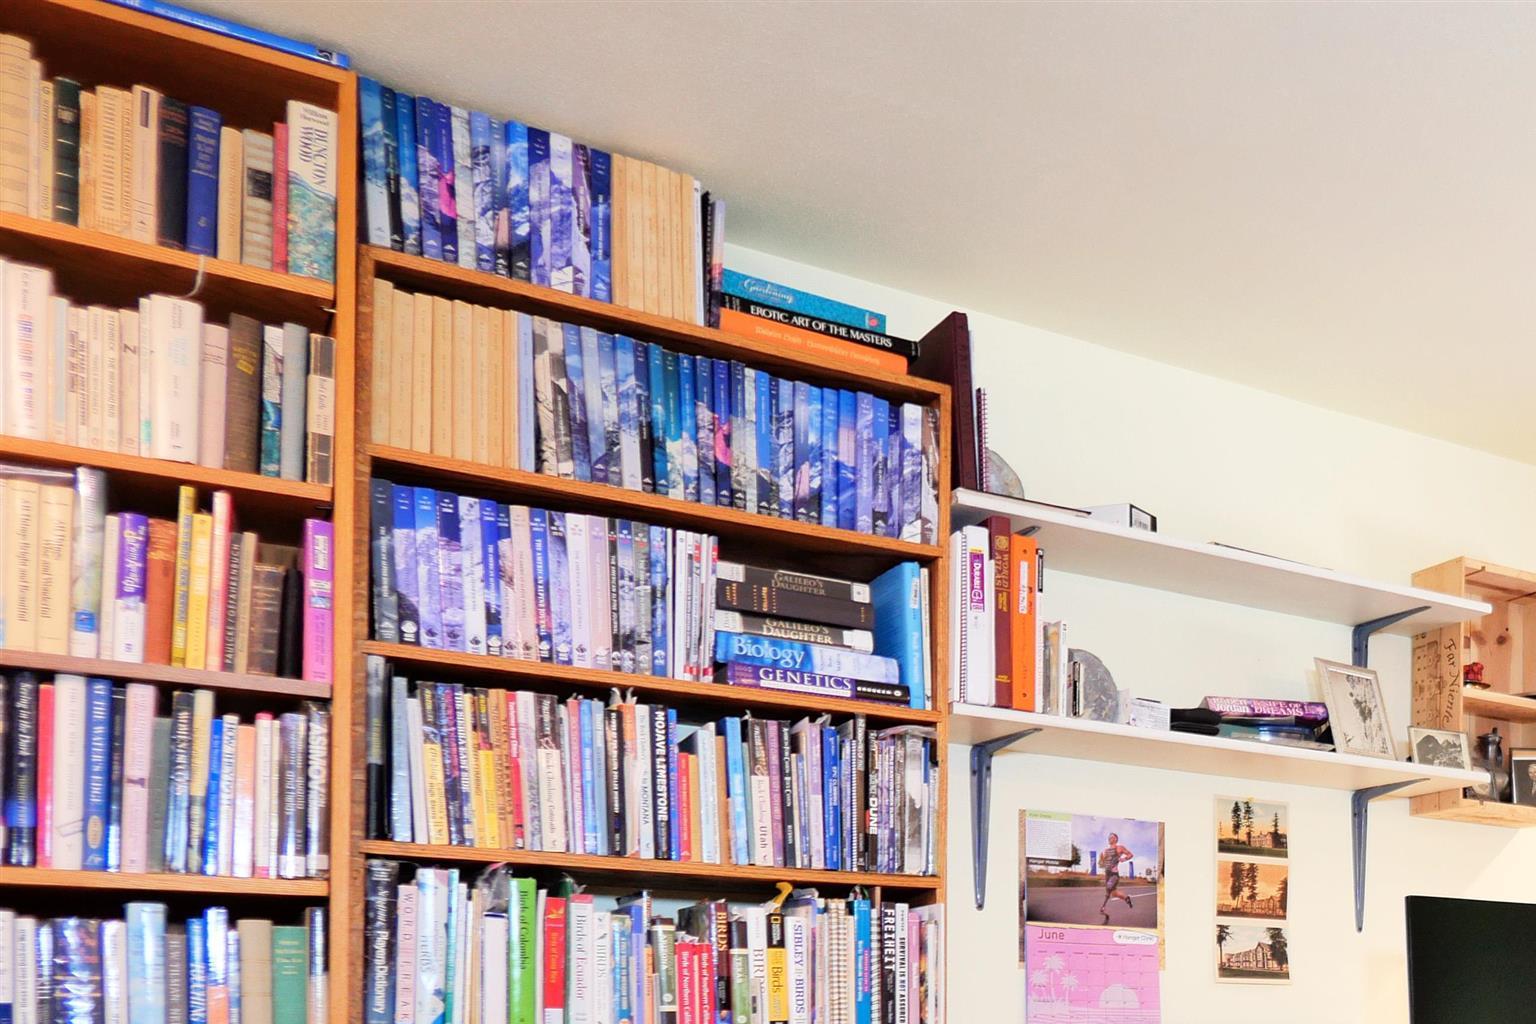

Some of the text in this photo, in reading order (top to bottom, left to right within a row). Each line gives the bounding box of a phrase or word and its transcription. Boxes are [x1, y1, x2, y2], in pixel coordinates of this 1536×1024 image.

[300, 126, 313, 163] WOOD
[313, 129, 331, 187] DUNCTON
[750, 305, 893, 348] EROTIC ART OF THE MASTERS
[18, 568, 30, 583] and
[42, 560, 52, 575] and
[536, 553, 544, 583] AMERICAN
[774, 572, 824, 588] GALILEO'S
[17, 585, 29, 622] Beautiful
[40, 577, 51, 619] Wonderful
[536, 584, 545, 607] ALPINE
[770, 581, 826, 596] DAUGHTER
[538, 608, 547, 635] JOURNAL
[762, 624, 833, 646] DAUGHTER
[733, 636, 805, 668] Biology
[759, 667, 852, 690] GENETICS
[1442, 638, 1460, 728] Far Niente
[19, 710, 30, 718] in
[92, 701, 105, 720] THE
[1215, 704, 1249, 712] Jordan
[1254, 707, 1304, 716] DREAMS
[19, 720, 31, 732] the
[454, 692, 470, 792] THE SIERRA EAST SIDE
[18, 734, 32, 755] Dark
[91, 726, 104, 772] WATER'S
[308, 723, 326, 793] ASIMOV
[655, 711, 668, 821] MOJAVE LIMESTONE
[90, 776, 103, 806] EDGE
[641, 786, 649, 825] MONTANA
[870, 797, 878, 834] DUNE
[760, 826, 769, 849] Utah
[519, 890, 529, 970] Birds of Colombia
[717, 912, 728, 951] BIRDS
[884, 909, 895, 971] FREIHEIT
[1038, 929, 1065, 940] June
[375, 930, 388, 966] Players
[401, 893, 414, 1021] WORD FREAK
[575, 915, 586, 1000] Birds of Ecuador
[596, 944, 606, 978] BIRDS
[772, 966, 783, 993] Birds
[793, 924, 805, 1014] SIBLEY BIRDS
[190, 962, 205, 1022] TOUCHING
[374, 966, 389, 1014] Dictionary
